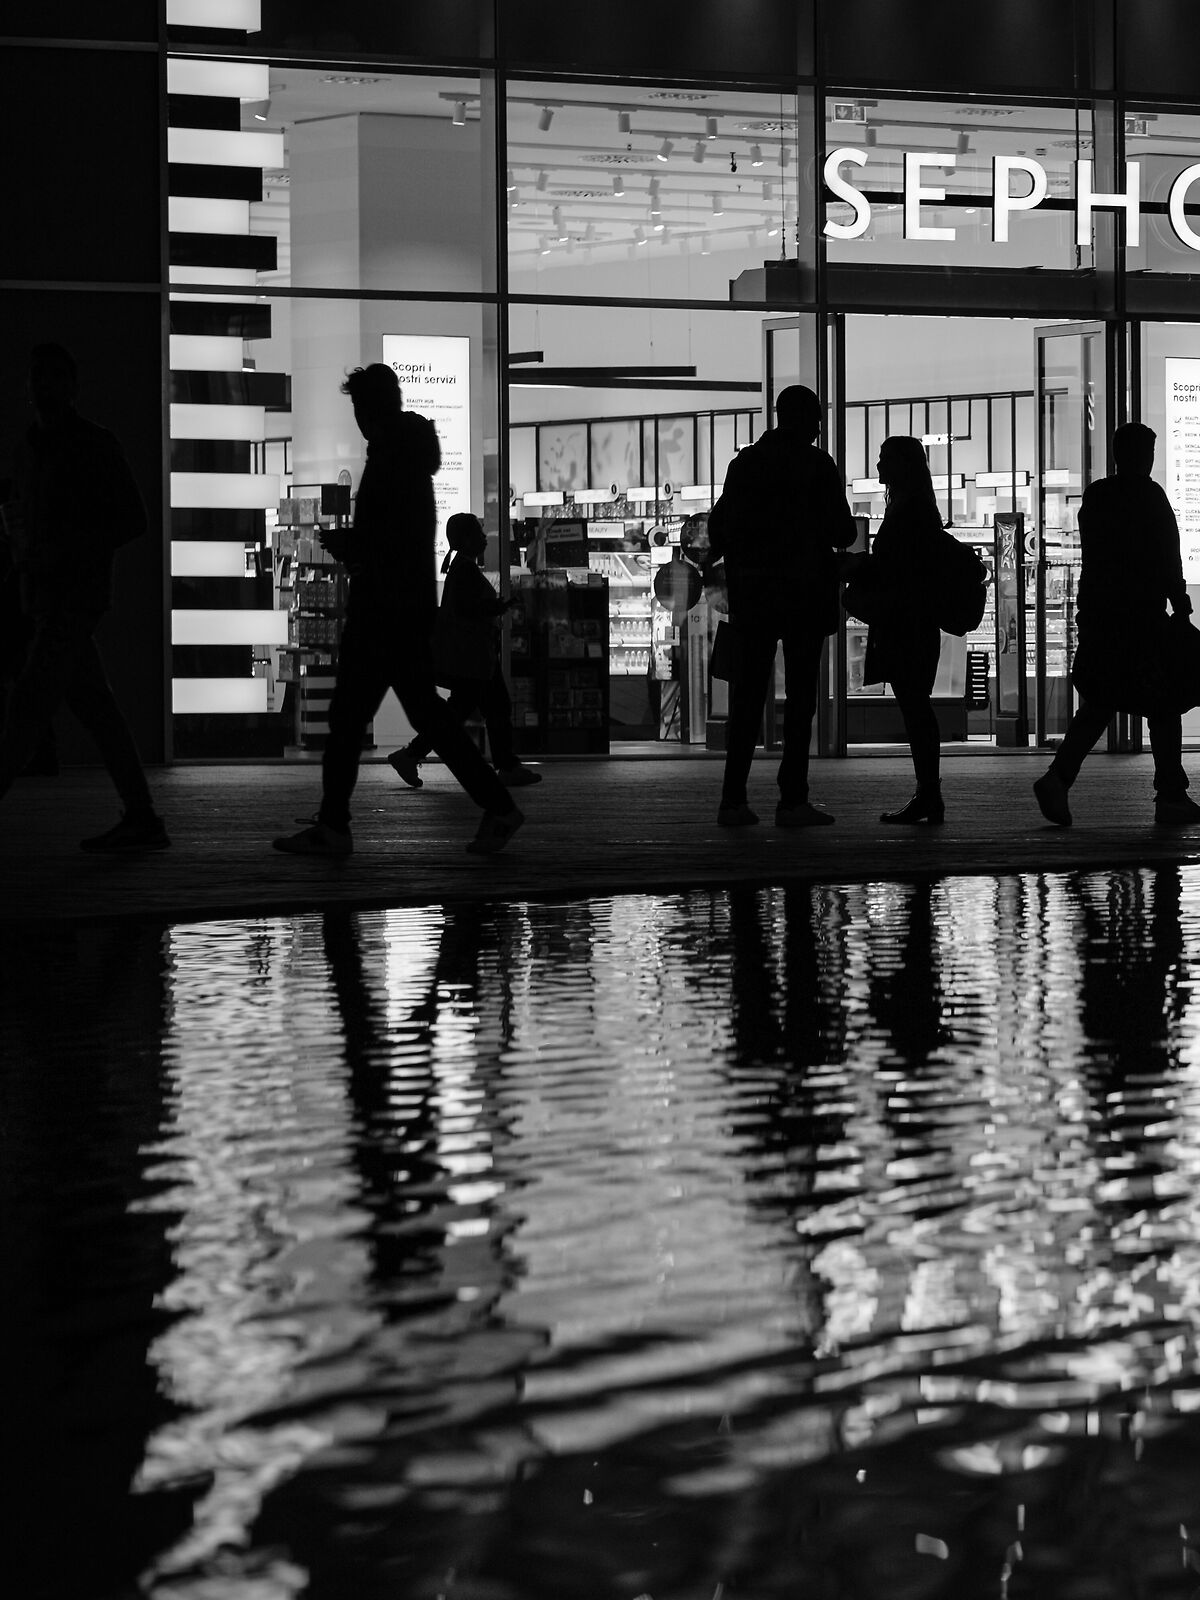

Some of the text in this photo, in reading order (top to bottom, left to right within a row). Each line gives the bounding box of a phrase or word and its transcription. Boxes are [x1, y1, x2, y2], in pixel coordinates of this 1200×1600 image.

[392, 361, 426, 373] Scopri
[398, 374, 456, 384] ostri servizi
[1173, 382, 1200, 393] Scopri
[1173, 394, 1197, 402] nostri
